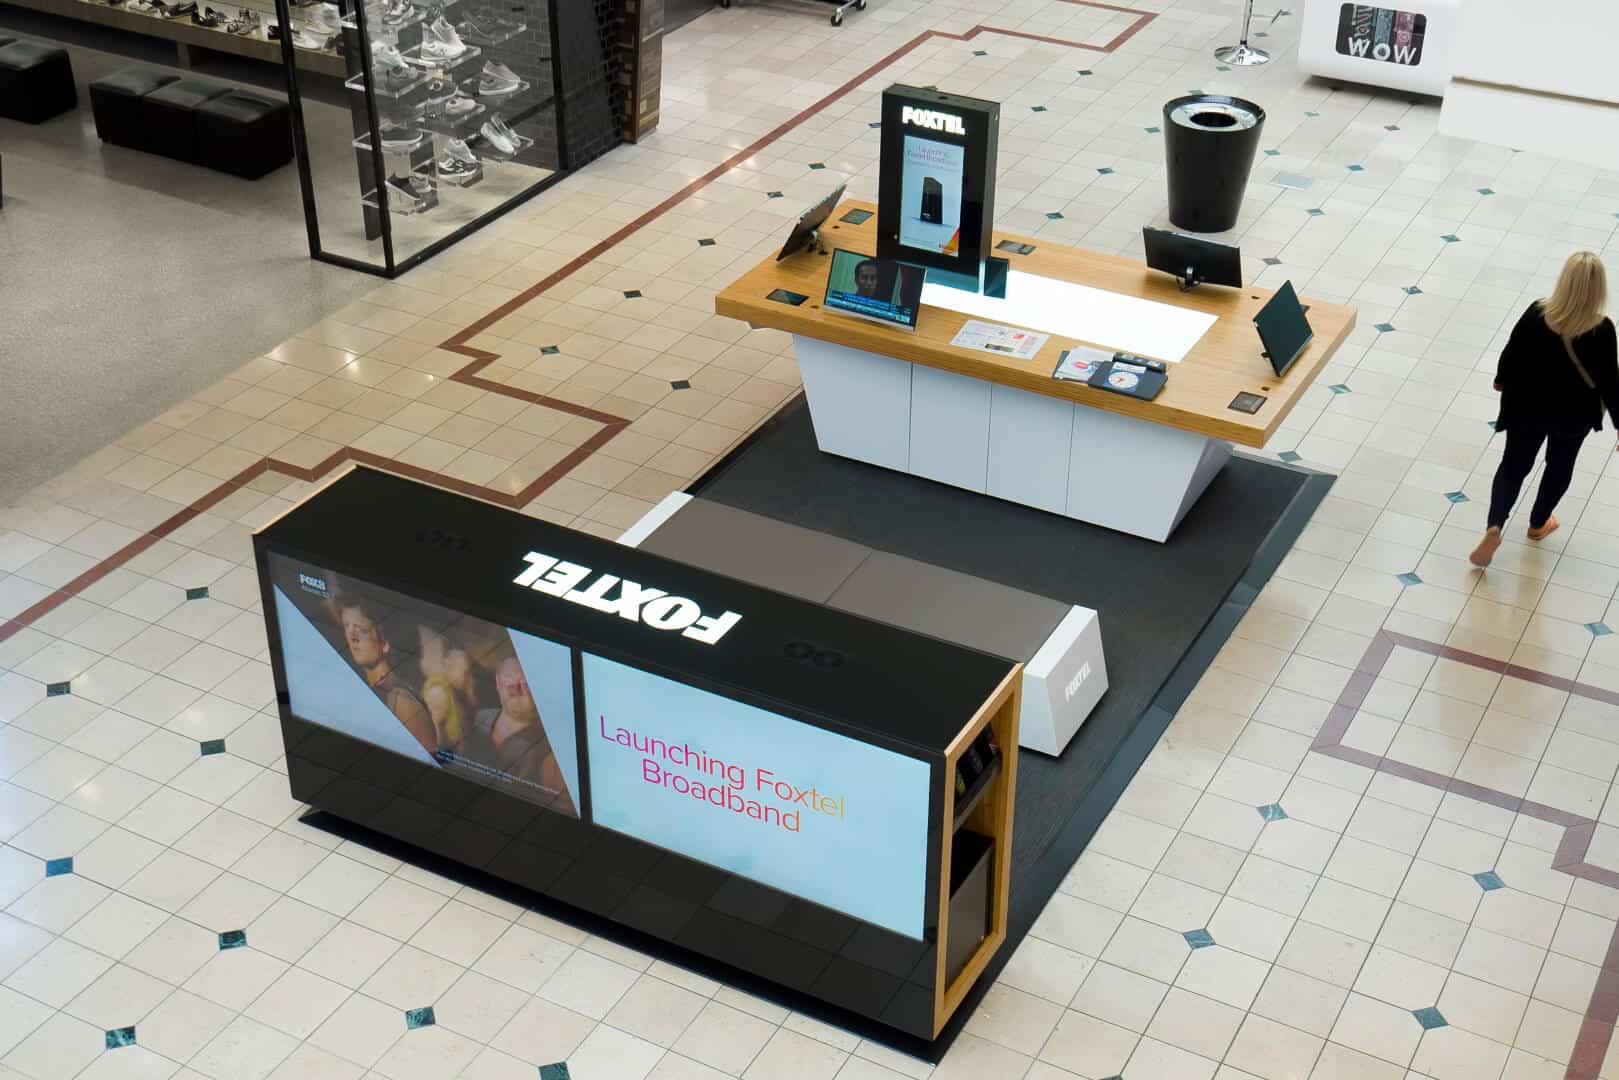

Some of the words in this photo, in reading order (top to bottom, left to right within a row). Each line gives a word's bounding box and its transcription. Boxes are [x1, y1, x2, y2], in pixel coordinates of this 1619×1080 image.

[1348, 37, 1417, 65] WOW
[902, 106, 966, 135] FOXTEL
[512, 551, 743, 645] FOXTEL
[600, 715, 745, 790] Launching
[756, 768, 845, 821] Foxtel
[642, 758, 801, 833] Broadband
